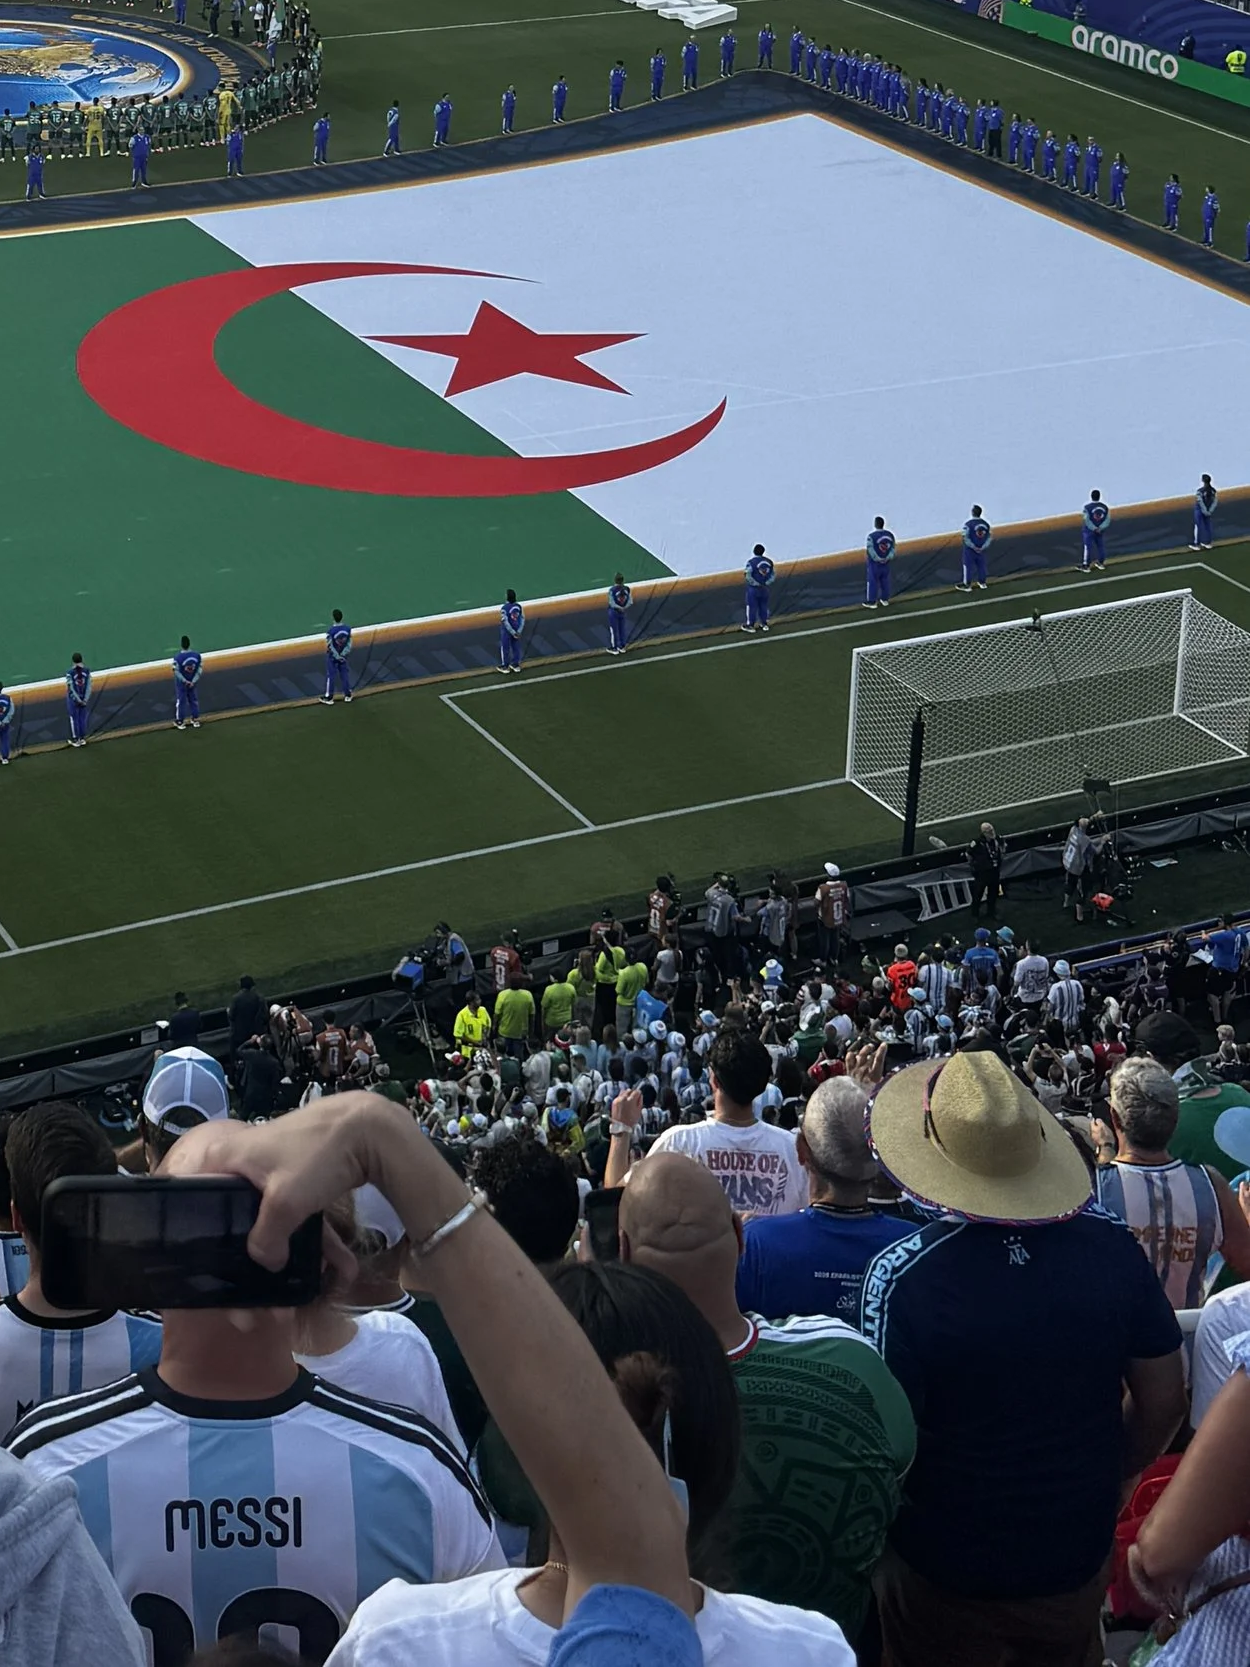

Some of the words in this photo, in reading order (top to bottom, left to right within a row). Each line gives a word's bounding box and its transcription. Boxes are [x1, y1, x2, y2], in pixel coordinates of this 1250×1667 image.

[1071, 24, 1180, 81] aramco
[706, 1149, 756, 1172] HOUSE
[757, 1153, 781, 1174] OF
[165, 1496, 303, 1553] MESSI
